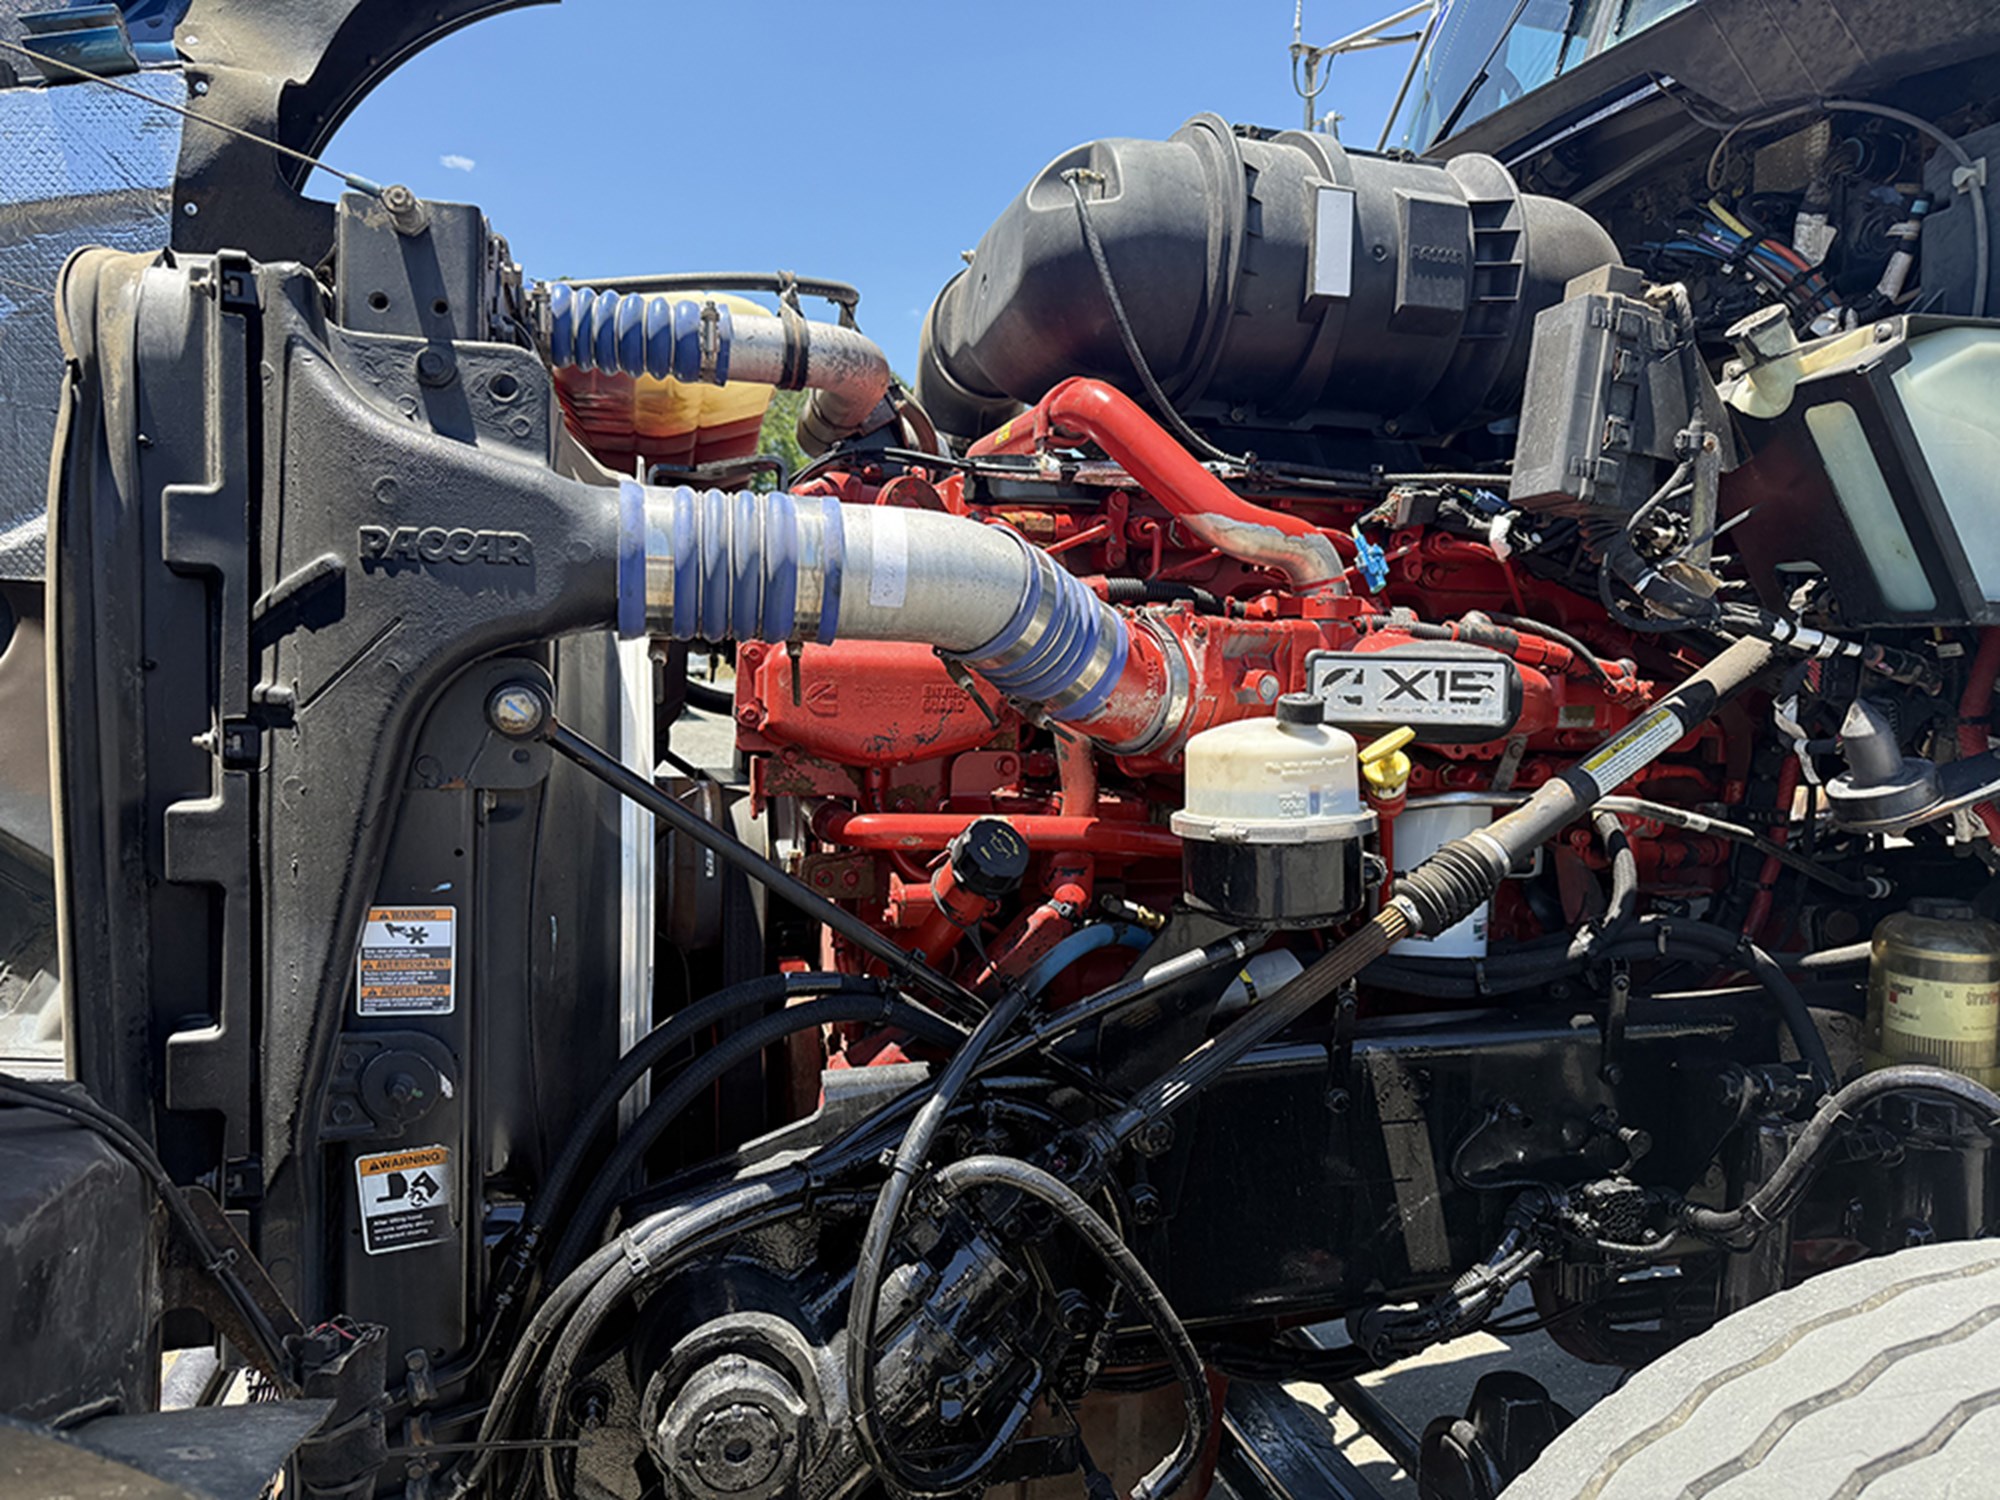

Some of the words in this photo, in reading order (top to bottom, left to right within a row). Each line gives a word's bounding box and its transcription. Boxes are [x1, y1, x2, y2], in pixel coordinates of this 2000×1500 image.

[357, 525, 534, 566] PACCAR
[1381, 667, 1495, 706] X15
[392, 910, 436, 920] WARNING
[380, 1151, 440, 1169] WARNING
